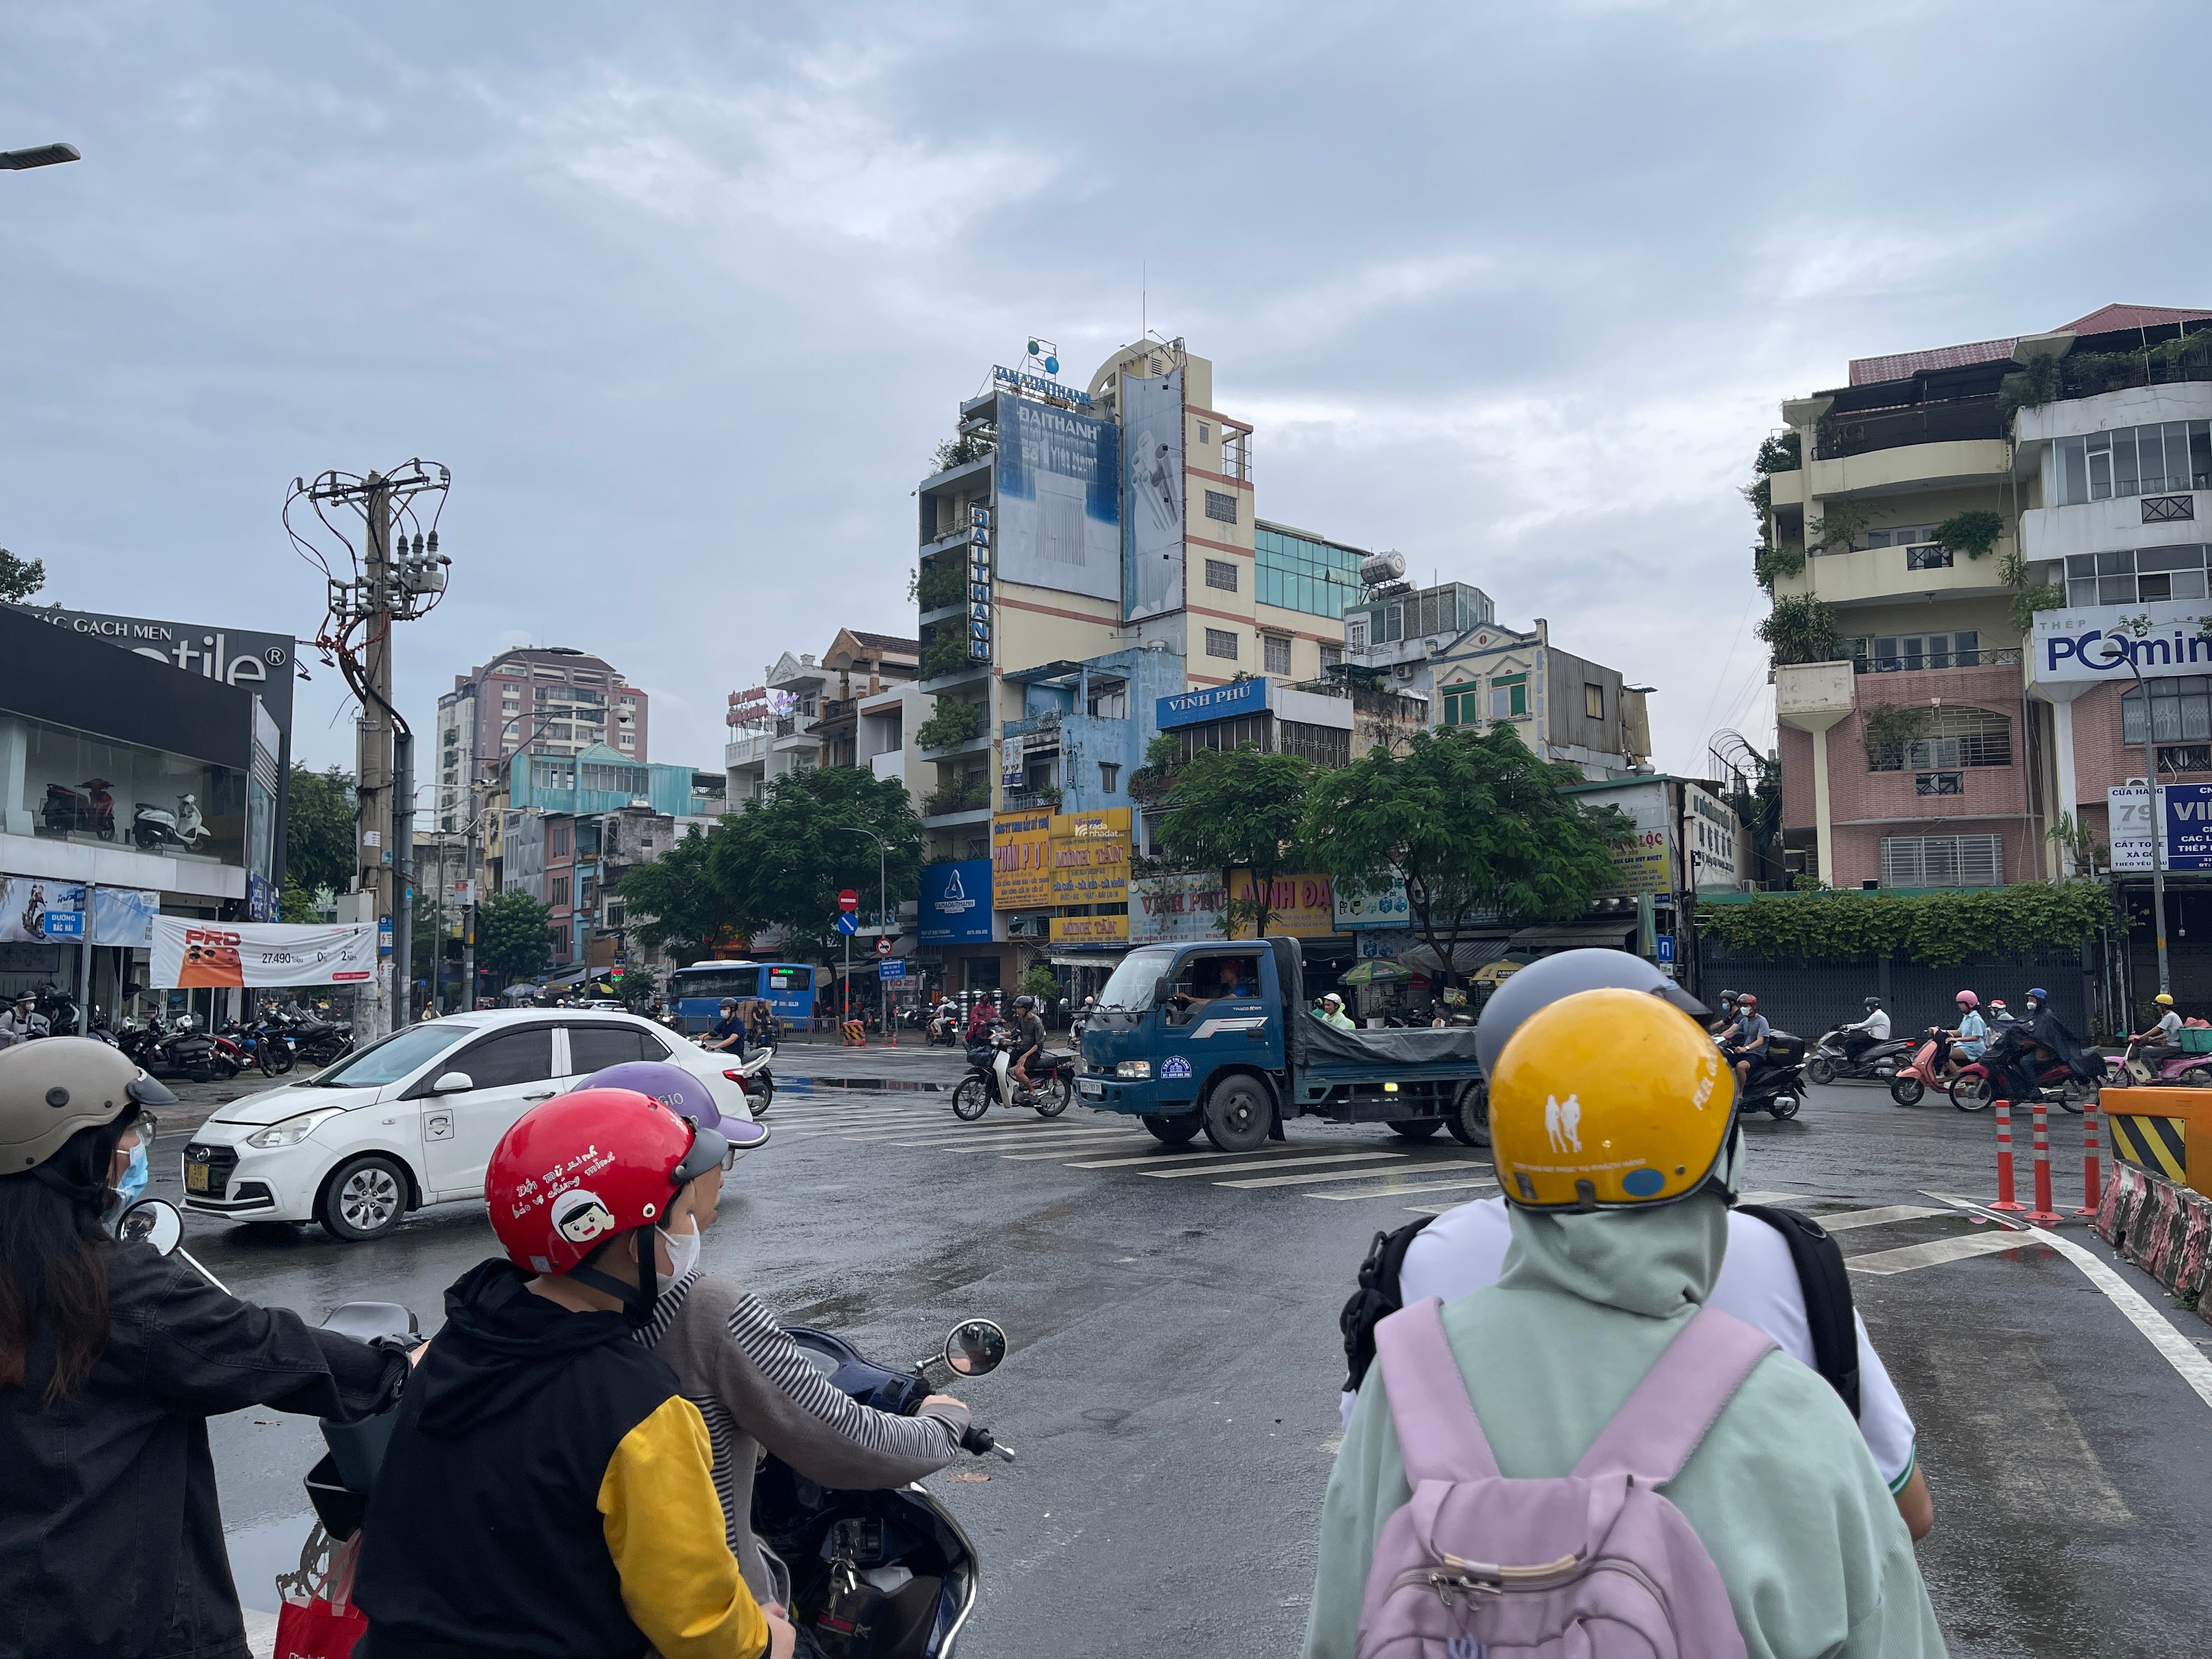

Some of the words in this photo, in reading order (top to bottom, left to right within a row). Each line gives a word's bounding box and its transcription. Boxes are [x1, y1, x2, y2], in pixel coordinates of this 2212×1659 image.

[73, 618, 128, 636] GẠCH
[133, 624, 173, 641] MEN
[2039, 618, 2086, 630] THÉP
[1169, 696, 1211, 712] VĨNH
[1215, 682, 1251, 704] PHÚ
[1638, 830, 1663, 849] LỘC
[52, 913, 76, 922] ĐƯỜNG
[185, 929, 241, 946] PRO
[516, 1178, 538, 1198] Đội
[543, 1164, 563, 1184] mũ
[567, 1144, 598, 1171] xinh
[547, 1176, 580, 1199] chúng
